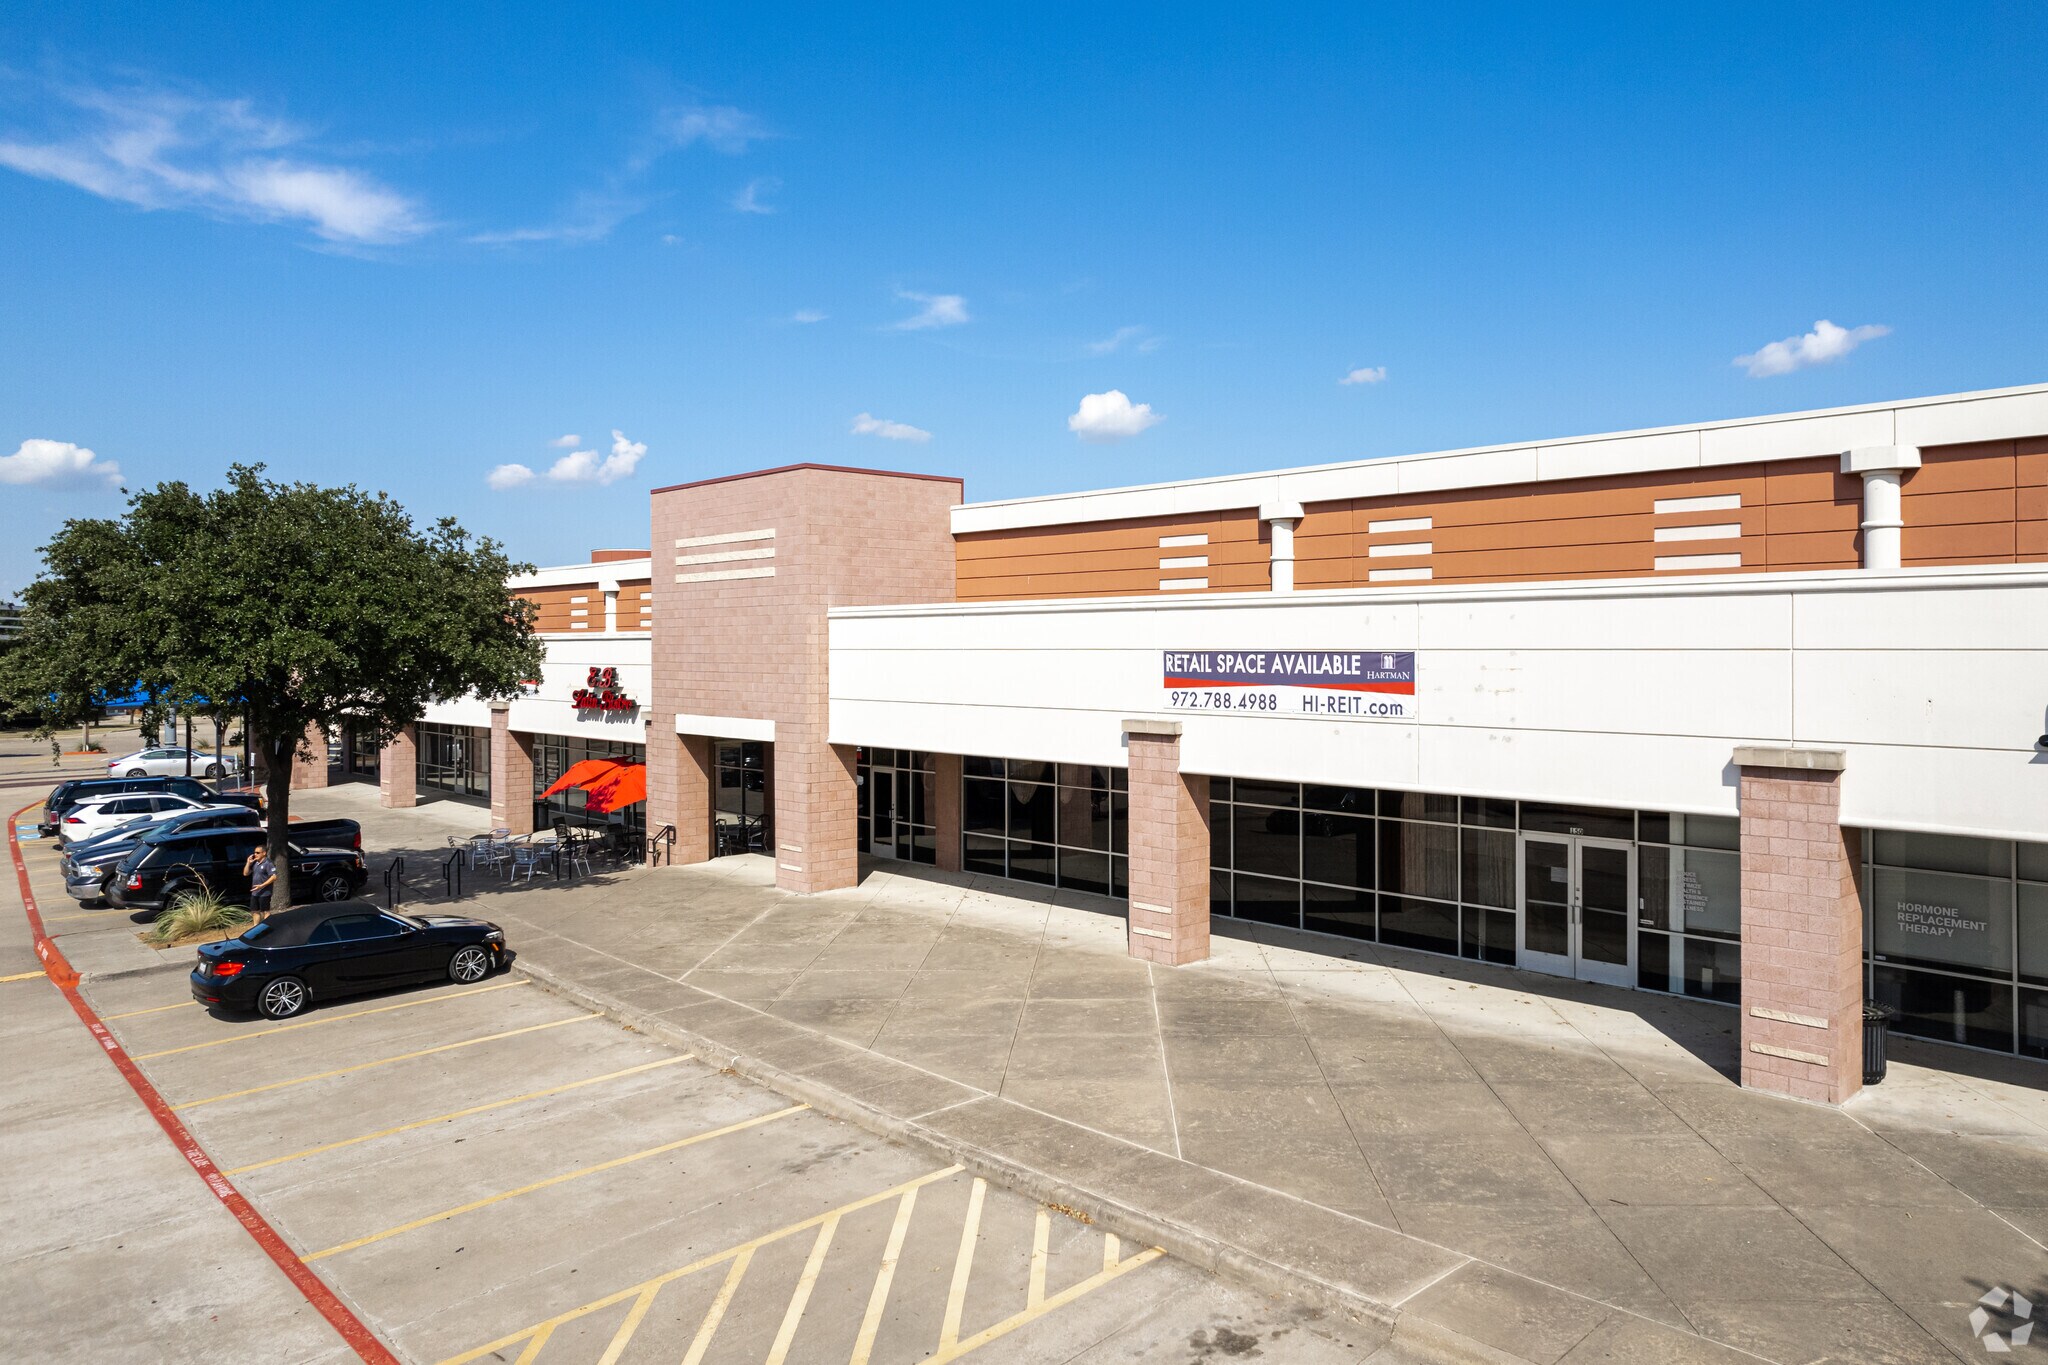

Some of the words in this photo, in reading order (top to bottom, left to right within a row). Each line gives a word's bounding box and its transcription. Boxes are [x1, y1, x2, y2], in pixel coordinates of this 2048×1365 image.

[1165, 653, 1212, 673] RETAIL
[1217, 653, 1266, 674] SPACE
[1271, 653, 1361, 675] AVAILABLE
[1366, 671, 1410, 680] HARTMAN
[571, 689, 599, 709] Latin
[600, 690, 633, 710] Bistro
[1171, 691, 1277, 711] 972.788.4988
[1302, 695, 1404, 715] HI-REIT.com
[1897, 901, 1959, 918] HORMONE
[1897, 912, 1987, 932] REPLACEMENT
[1897, 922, 1954, 938] THERAPY
